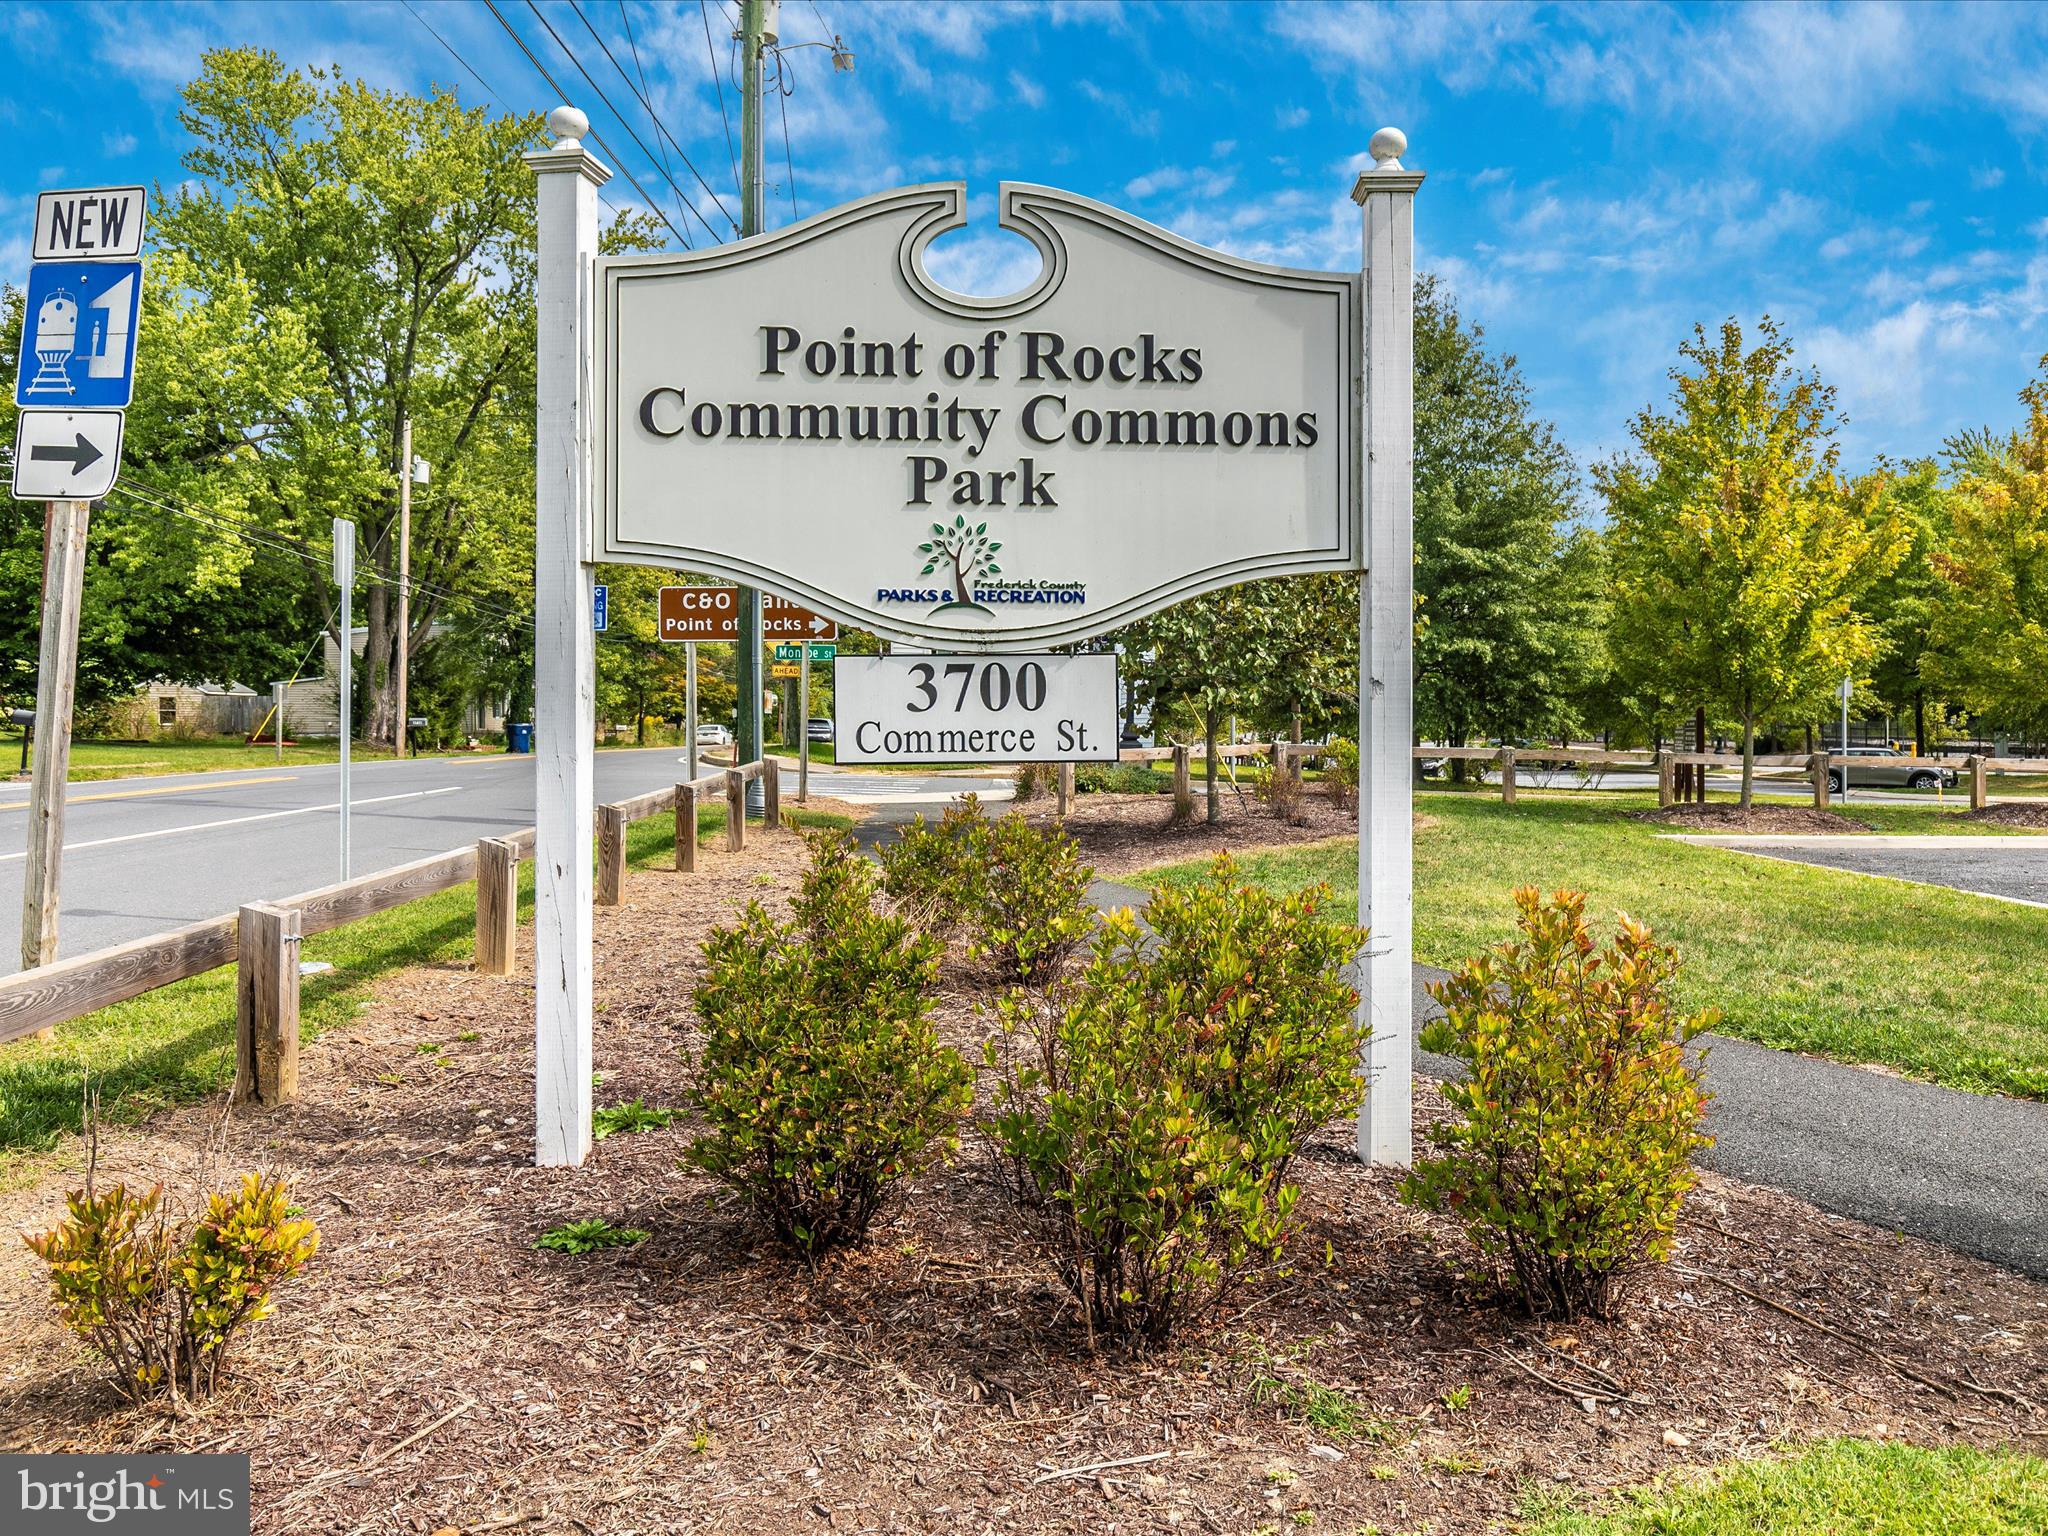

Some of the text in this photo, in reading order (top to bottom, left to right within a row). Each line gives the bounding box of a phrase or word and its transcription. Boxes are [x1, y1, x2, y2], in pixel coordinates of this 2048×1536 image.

[49, 197, 129, 250] NEW
[759, 325, 1203, 384] Point of Rocks
[639, 386, 1319, 457] Community Commons
[906, 455, 1058, 507] Park
[974, 579, 1087, 592] Frederick County
[682, 592, 731, 609] C&O
[877, 588, 954, 603] PARKS &
[974, 590, 1086, 604] RECREATION
[666, 617, 802, 631] Point of ocks
[779, 646, 832, 658] Monoe St
[774, 667, 799, 675] AHEAD
[906, 662, 1047, 713] 3700
[855, 719, 1098, 754] Commerce St.
